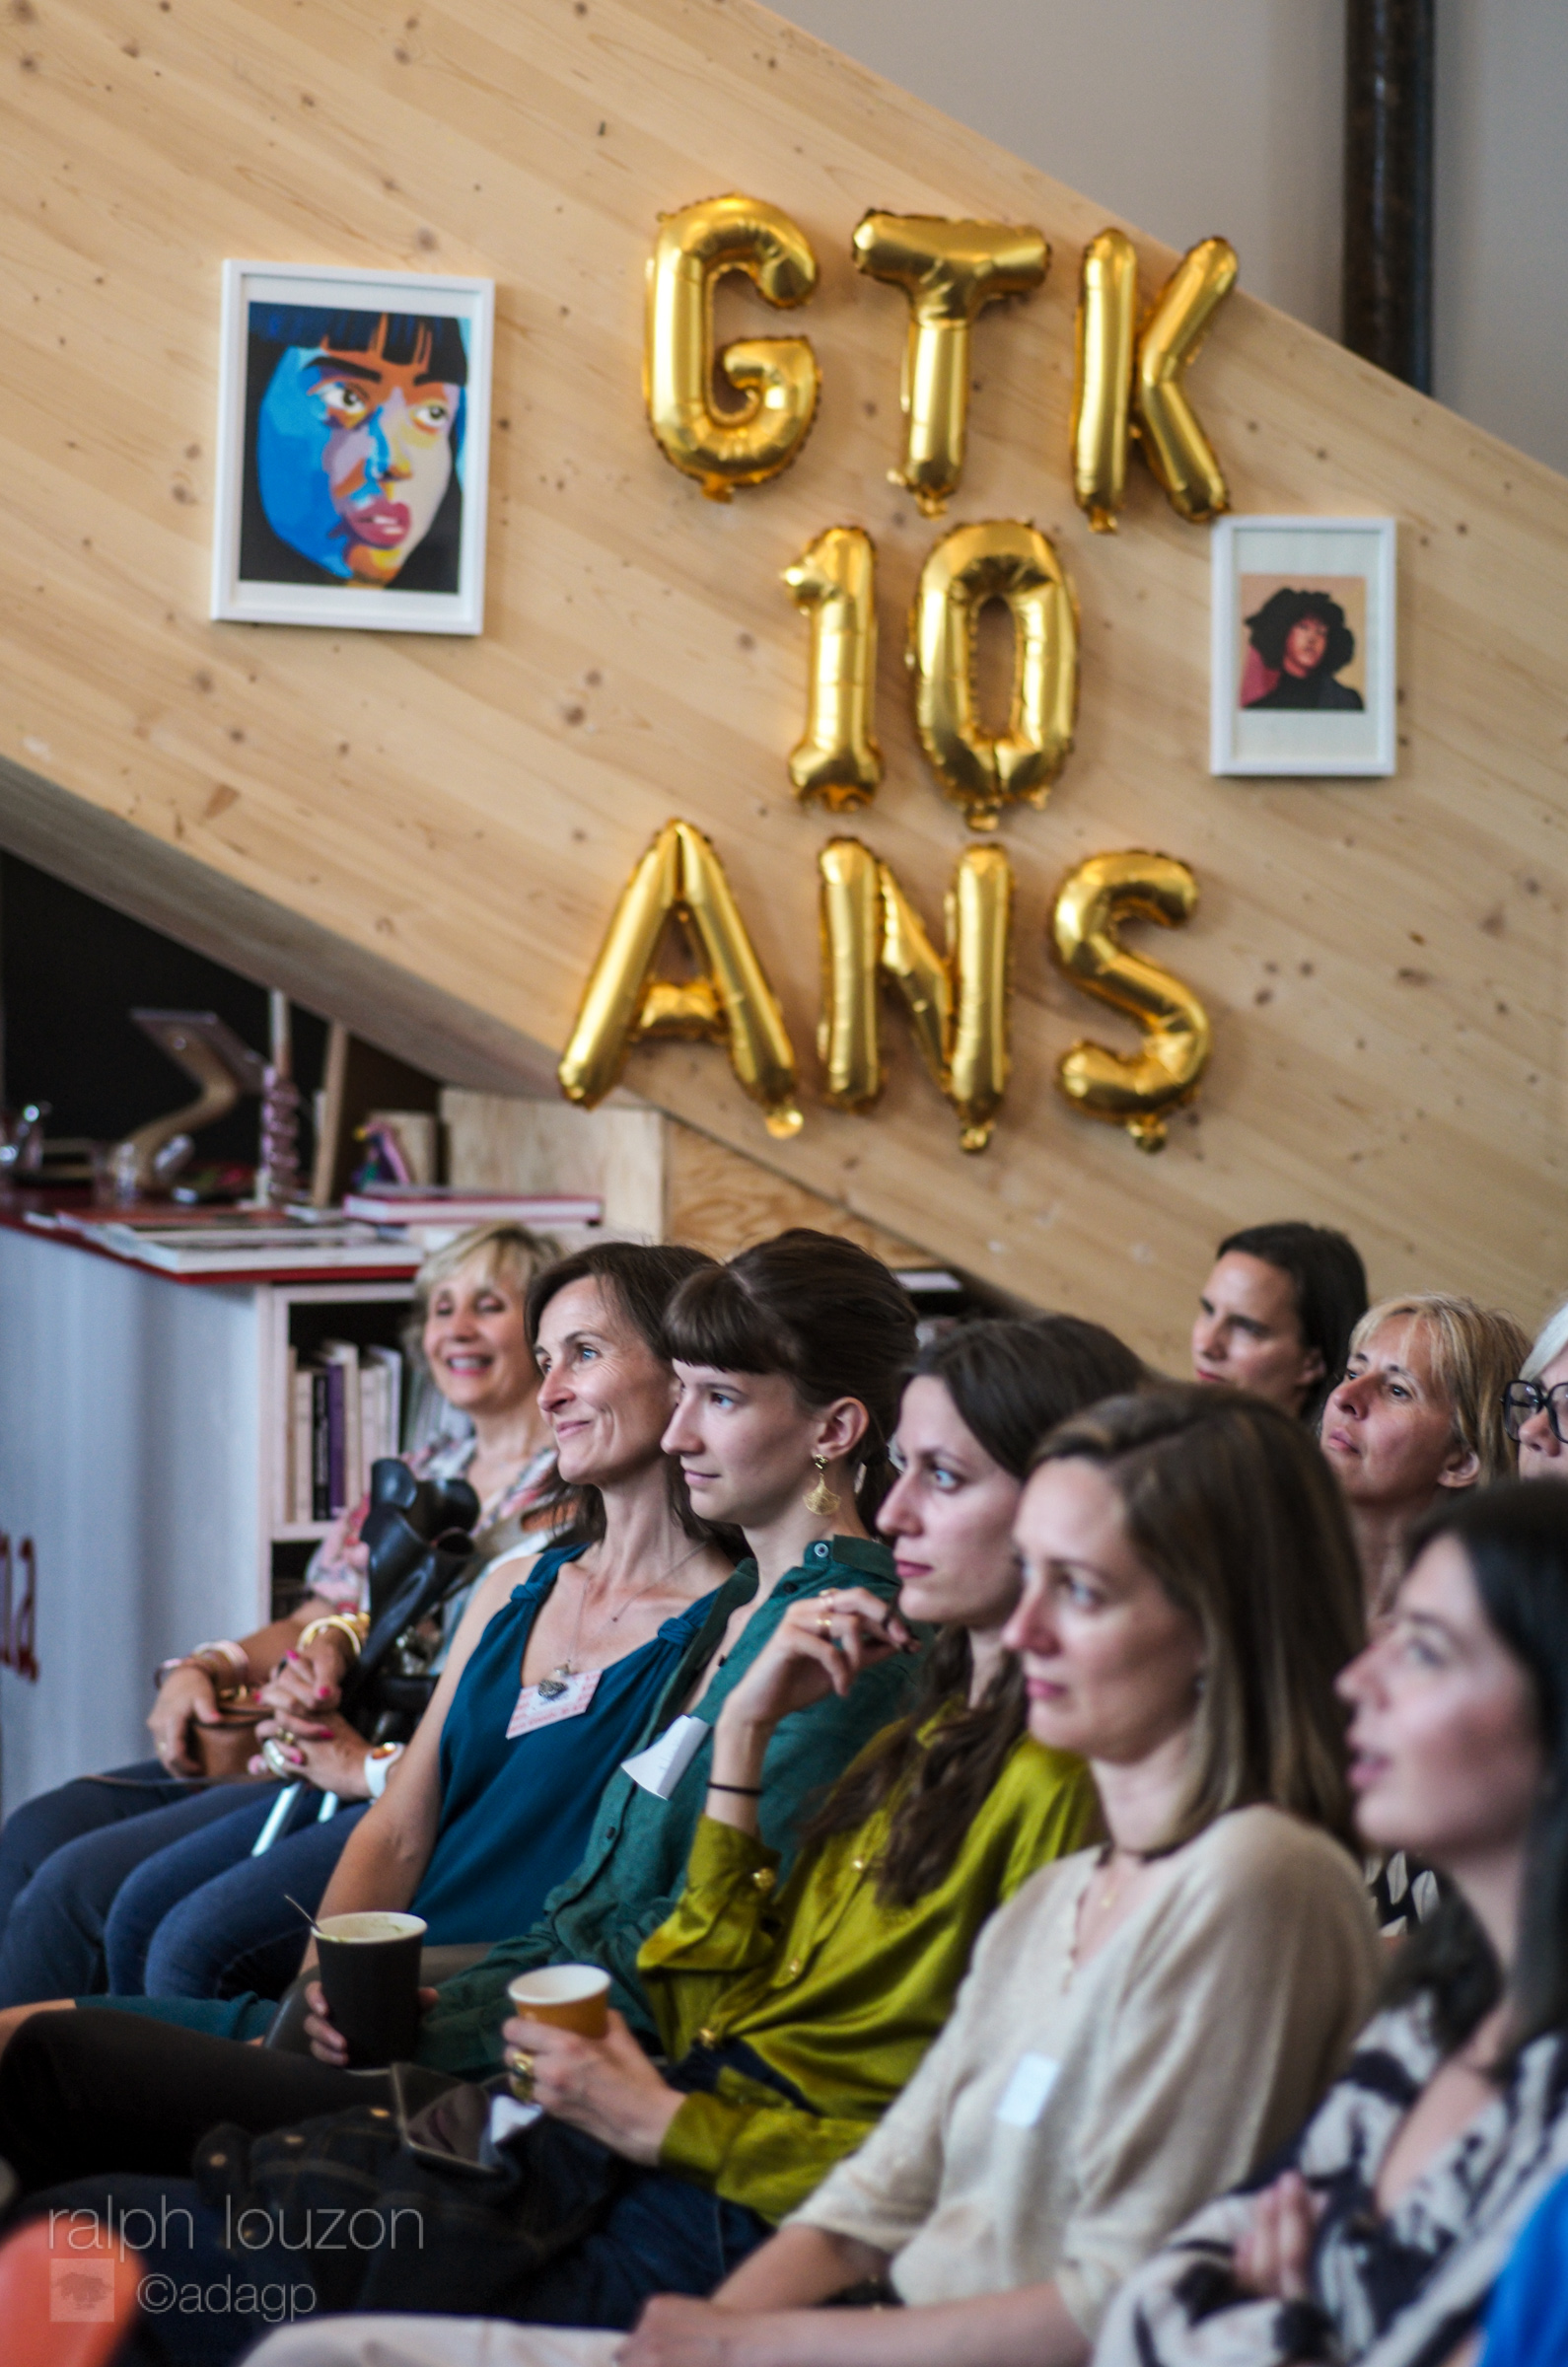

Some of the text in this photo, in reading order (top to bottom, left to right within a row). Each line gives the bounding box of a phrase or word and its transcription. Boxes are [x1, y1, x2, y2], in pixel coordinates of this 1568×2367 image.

[643, 193, 1239, 533] GTK
[781, 520, 1081, 829] 10
[558, 818, 1211, 1152] ANS
